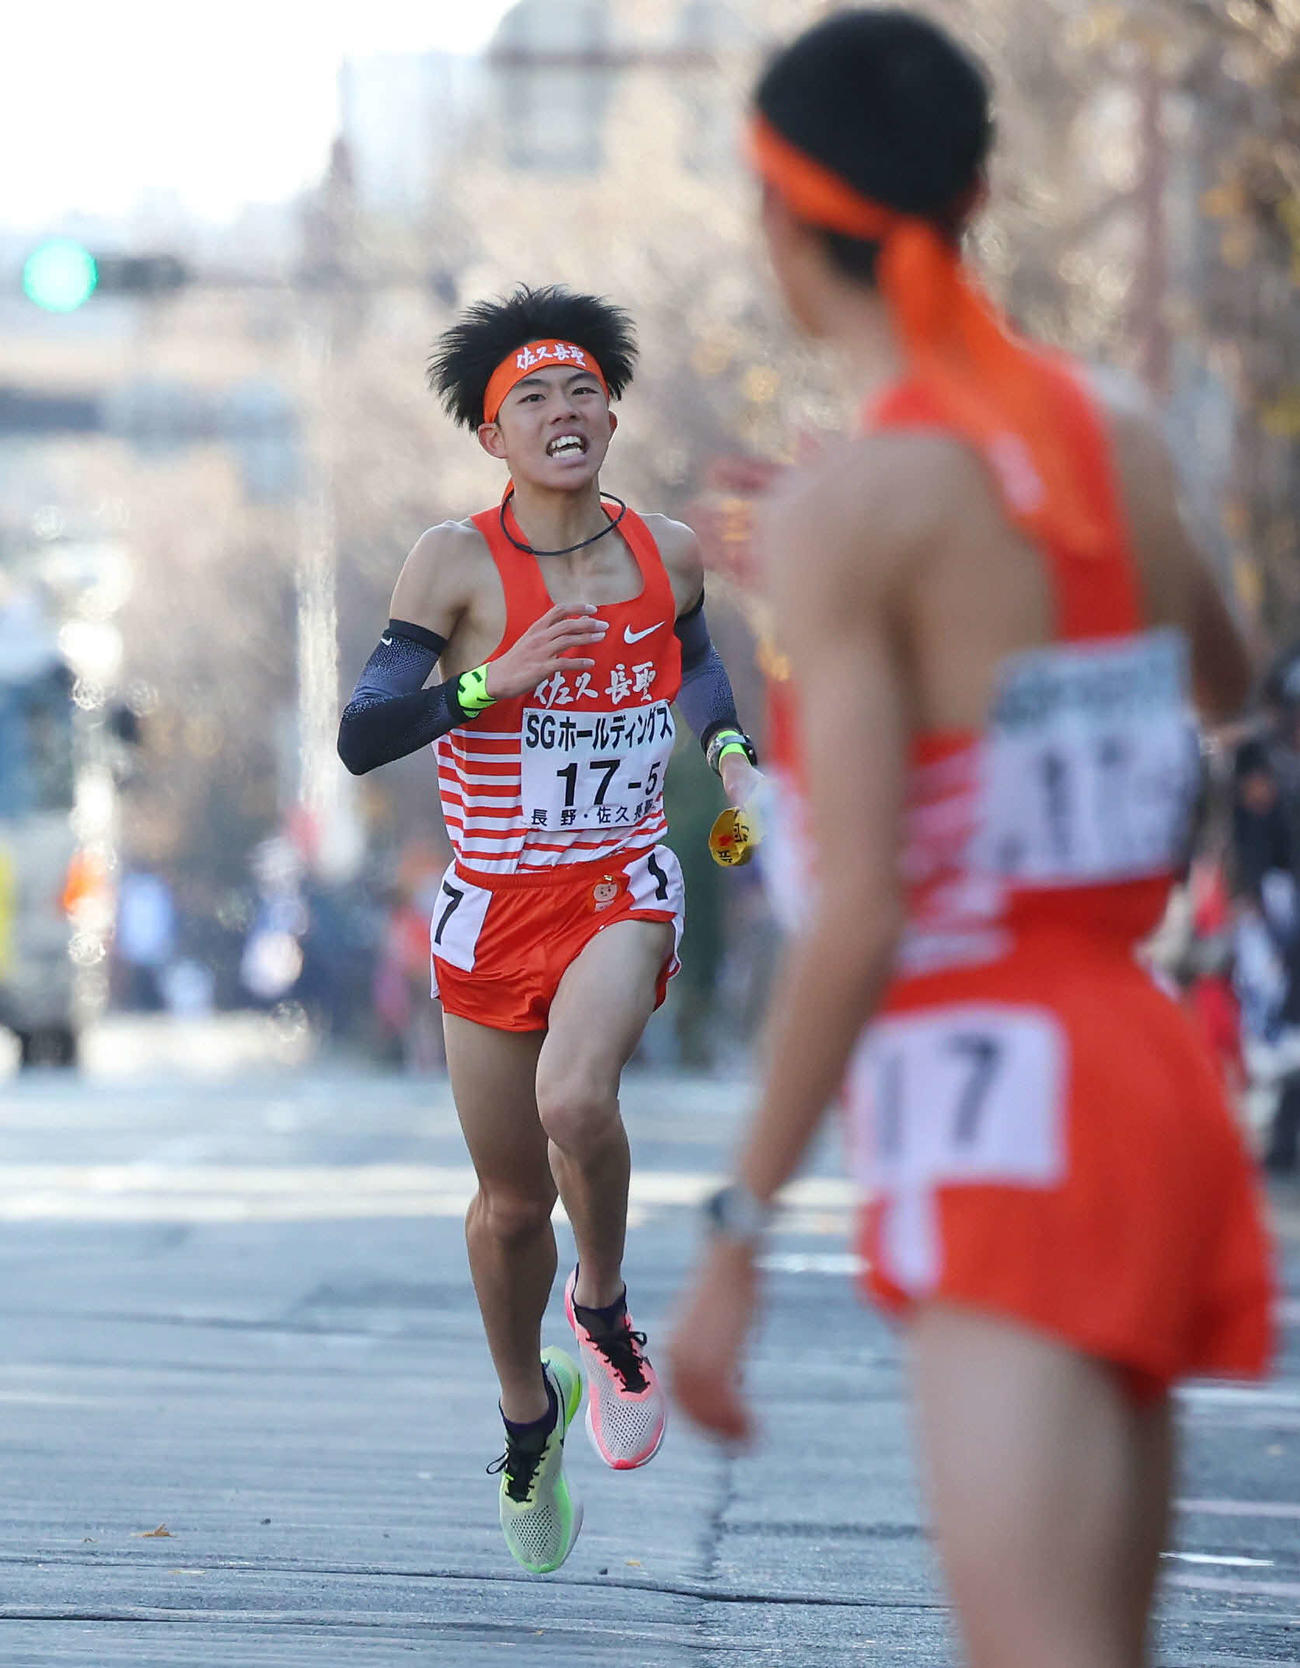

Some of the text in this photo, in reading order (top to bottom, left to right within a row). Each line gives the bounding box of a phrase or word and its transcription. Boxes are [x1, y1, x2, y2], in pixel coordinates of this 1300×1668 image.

[516, 343, 587, 370] 佐久長聖
[533, 661, 656, 709] 佐久長聖
[525, 707, 673, 752] SGホールディングス
[556, 758, 661, 808] 17-5
[433, 879, 465, 946] 7
